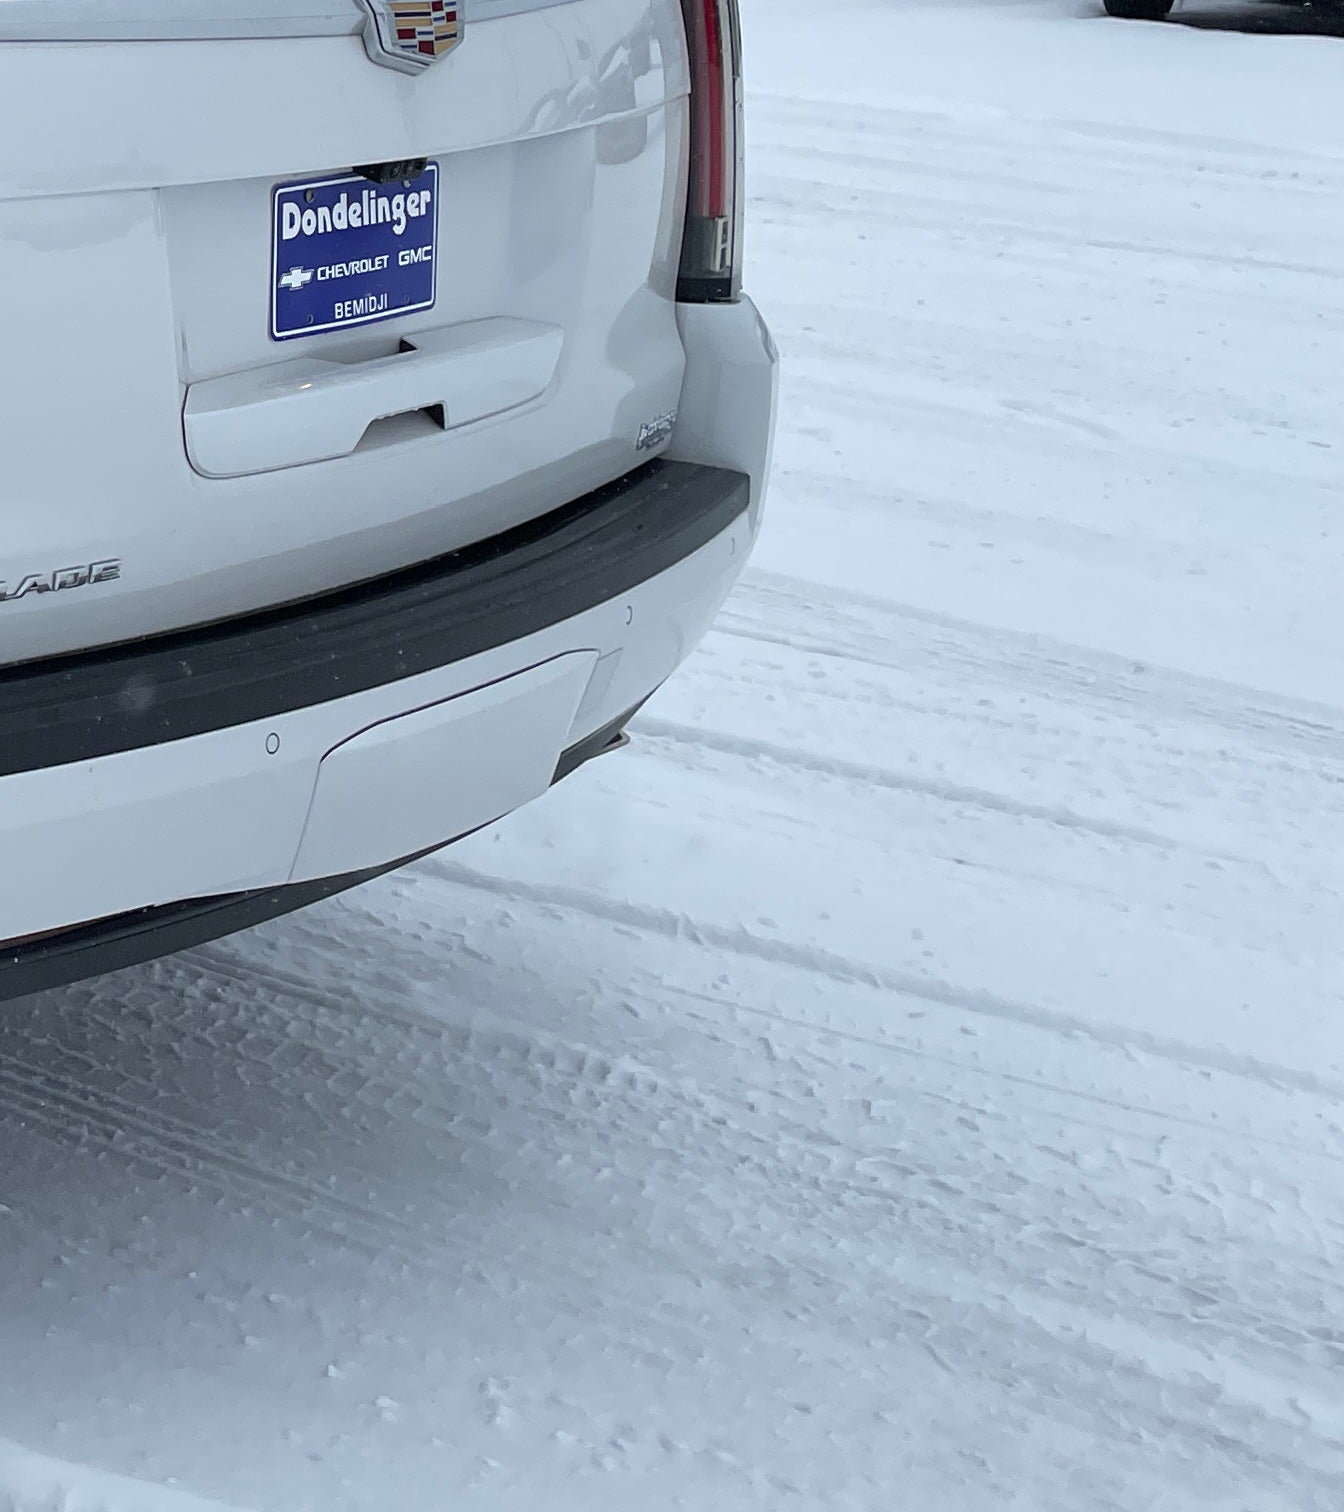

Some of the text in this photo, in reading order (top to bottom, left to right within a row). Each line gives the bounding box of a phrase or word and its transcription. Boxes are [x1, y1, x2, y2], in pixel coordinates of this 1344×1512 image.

[282, 189, 432, 241] Dondelinger
[317, 245, 432, 281] CHEVROLET GMC
[334, 293, 388, 319] BEMIDJI
